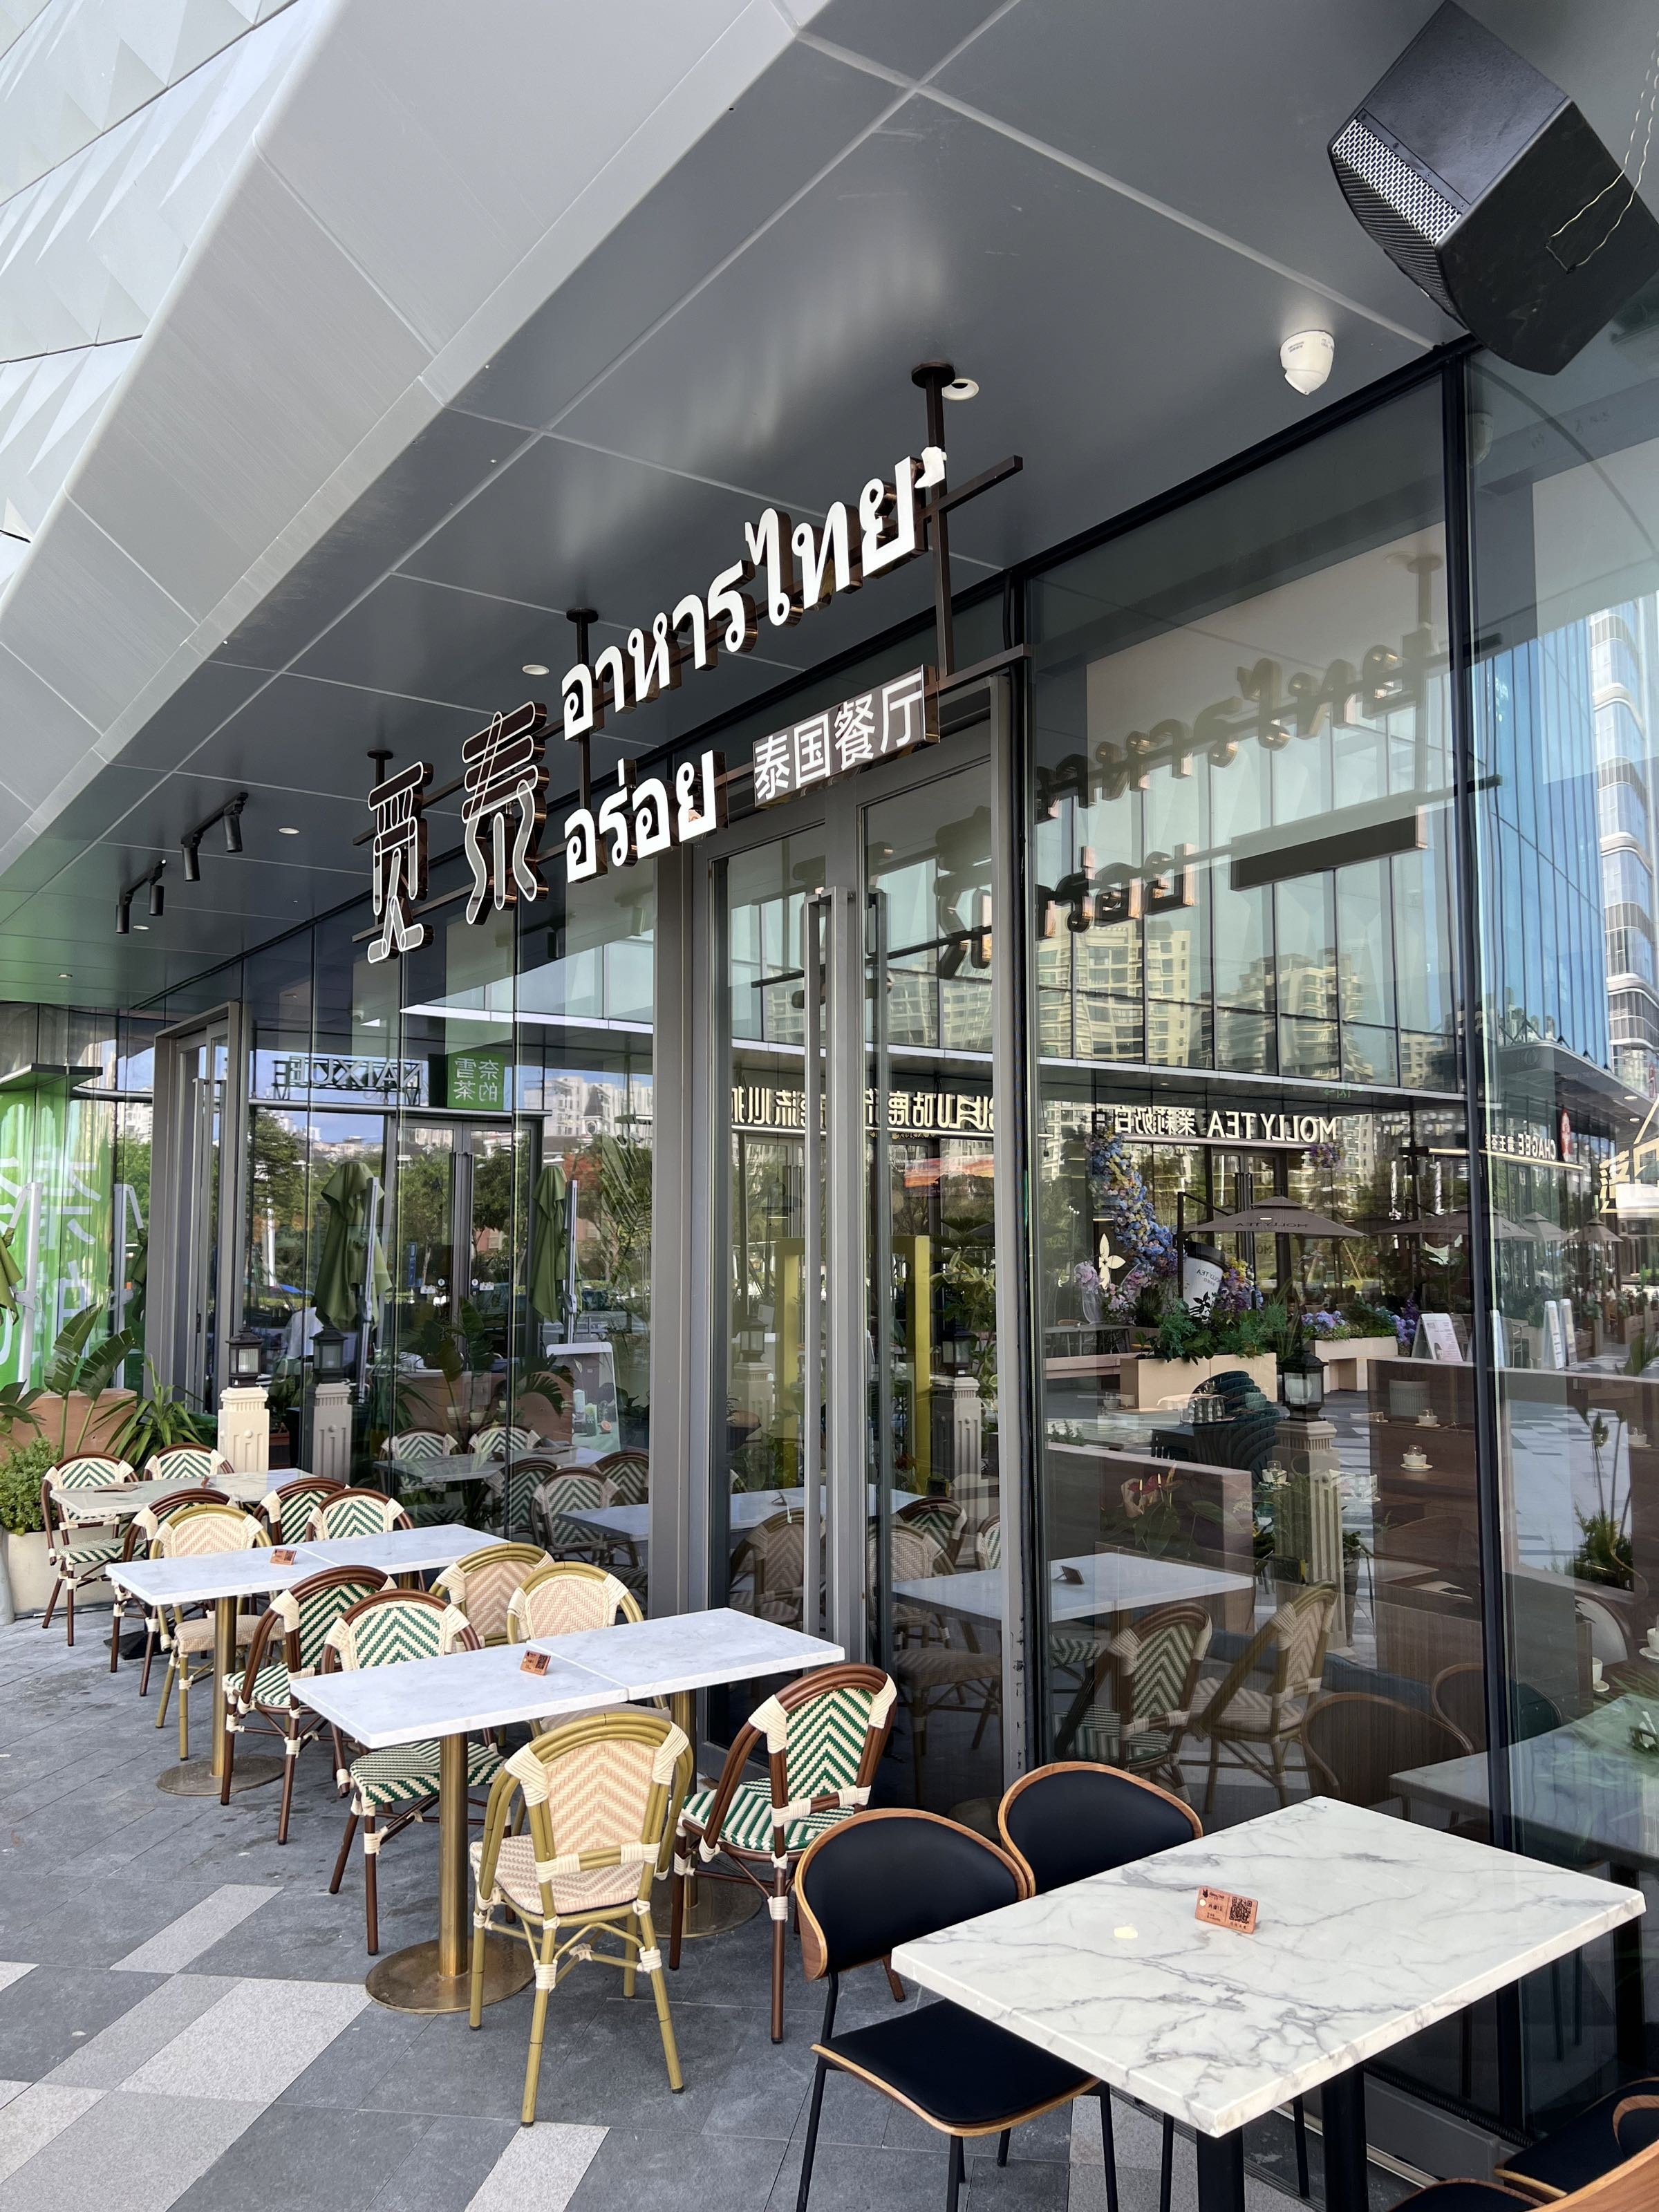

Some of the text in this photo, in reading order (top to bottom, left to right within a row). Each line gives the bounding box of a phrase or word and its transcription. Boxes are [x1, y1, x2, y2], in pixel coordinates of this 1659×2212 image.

[561, 455, 921, 741] อาหารไทย
[753, 673, 924, 802] 泰国餐厅
[563, 750, 720, 883] อร่อย
